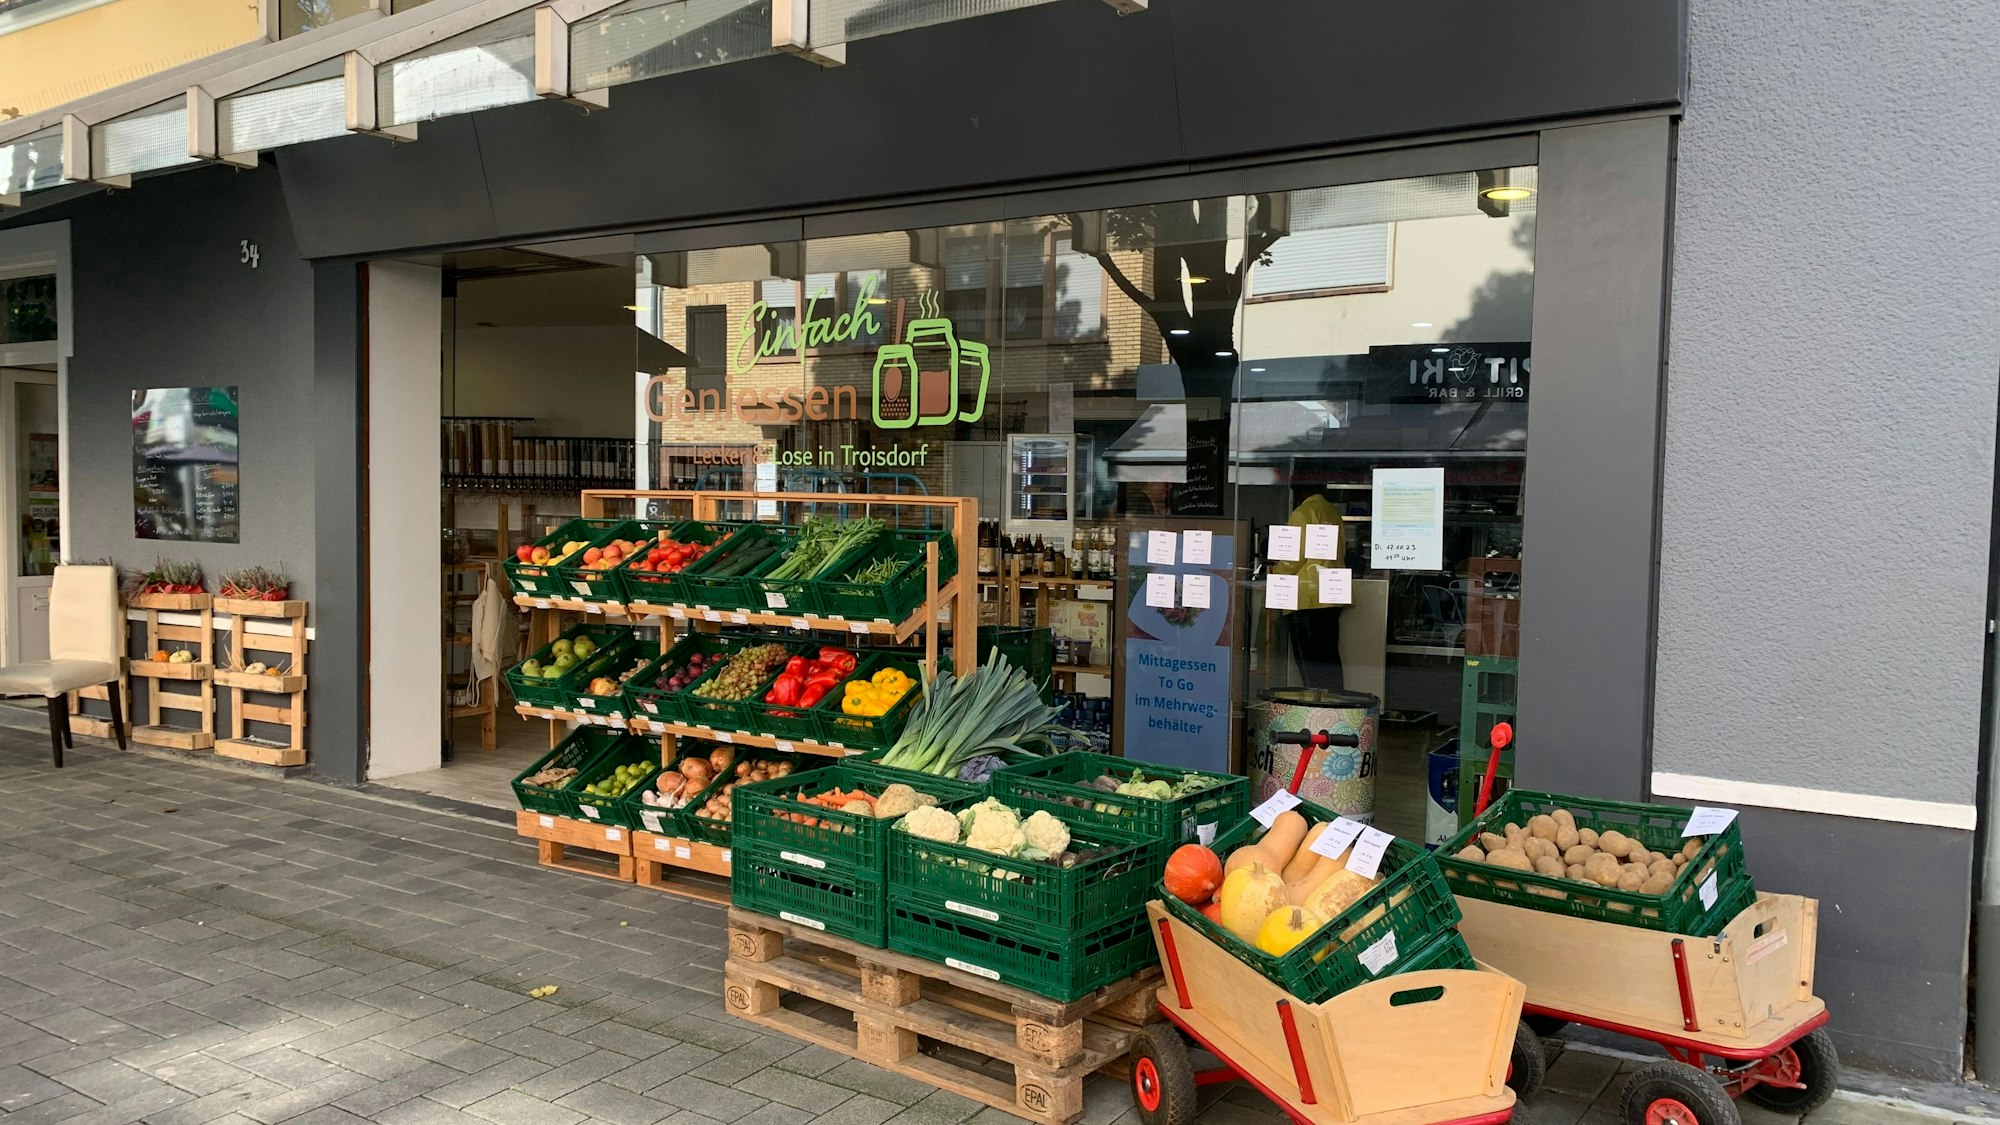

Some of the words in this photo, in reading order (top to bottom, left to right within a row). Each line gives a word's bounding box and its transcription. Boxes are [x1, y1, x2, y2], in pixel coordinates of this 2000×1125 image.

[240, 239, 260, 269] 34
[733, 273, 881, 375] Einfach
[644, 374, 858, 423] Geniessen
[692, 444, 746, 465] Lecker
[773, 446, 813, 466] Lose
[818, 444, 835, 466] in
[840, 443, 929, 467] Troisdorf
[1137, 653, 1217, 673] Mittagessen
[1158, 676, 1174, 690] To
[1176, 677, 1194, 692] Go
[1135, 693, 1151, 708] im
[1153, 694, 1219, 719] Mehrweg-
[1148, 715, 1204, 735] behälter
[731, 989, 748, 1006] EPAL
[1024, 1087, 1048, 1108] EPAL
